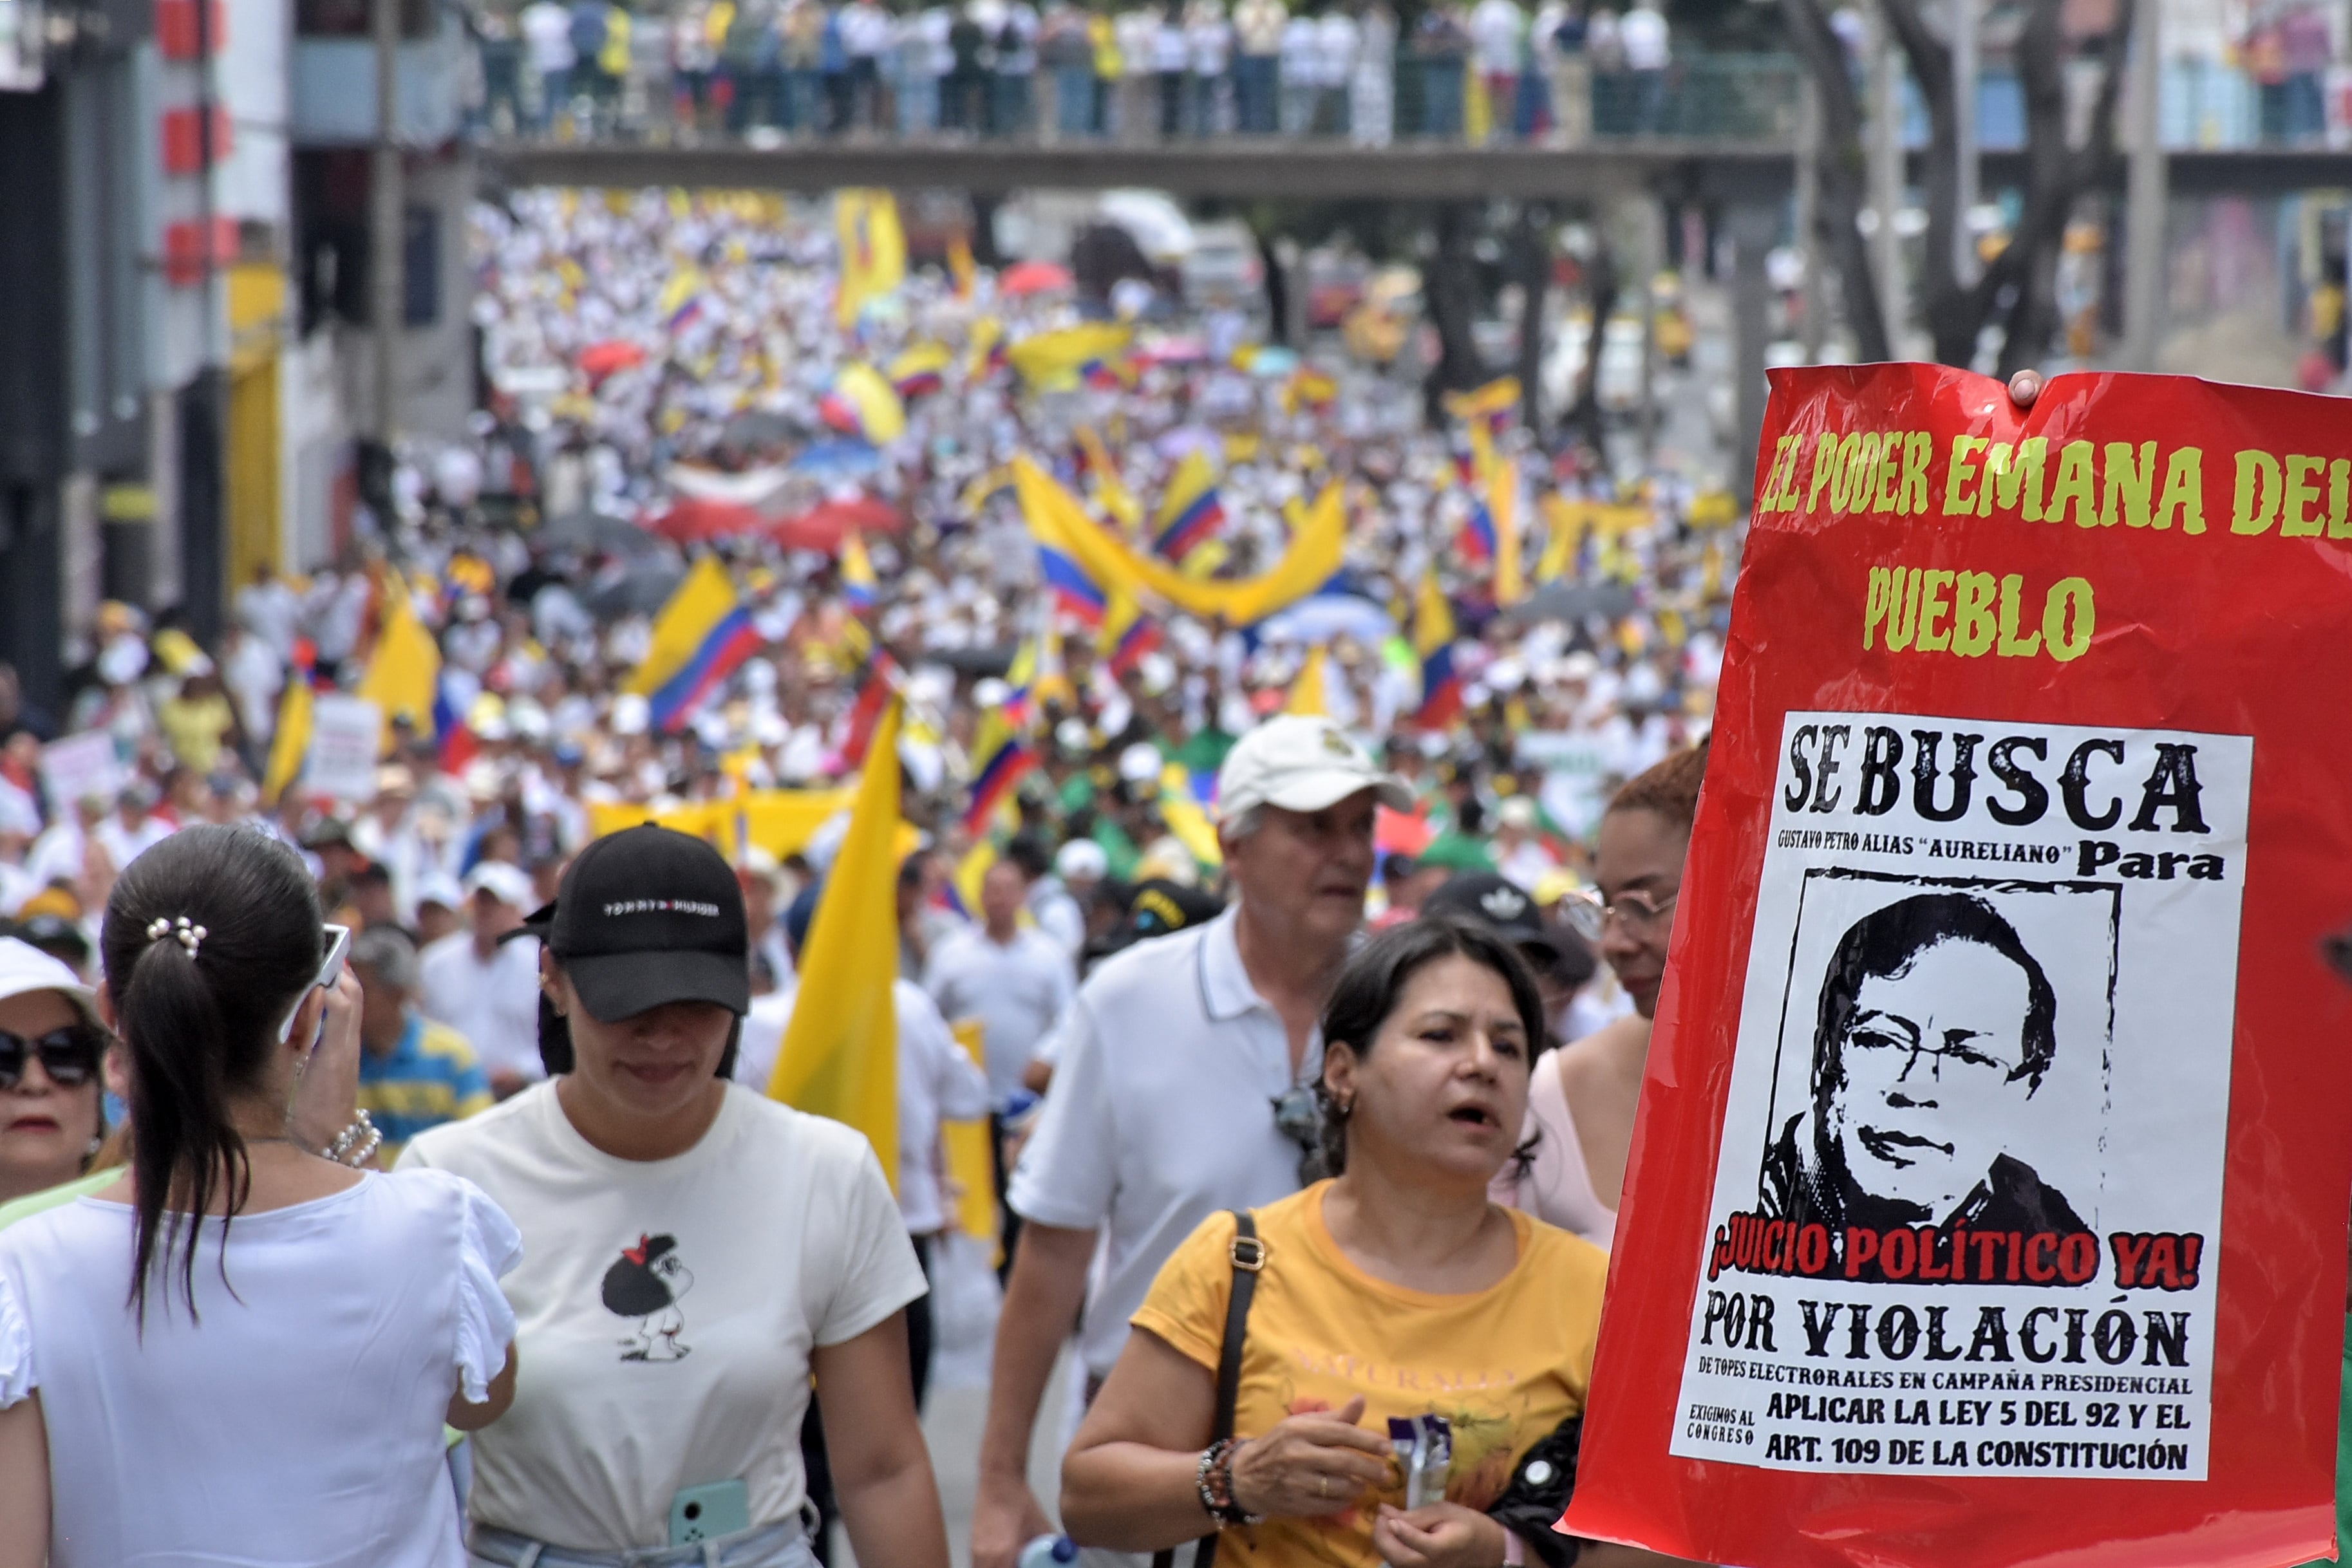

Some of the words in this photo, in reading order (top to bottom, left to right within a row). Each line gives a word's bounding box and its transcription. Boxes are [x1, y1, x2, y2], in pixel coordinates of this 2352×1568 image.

[1760, 433, 1803, 514] EL
[1806, 430, 1932, 516] PODER
[1942, 434, 2206, 536] EMANA
[2230, 449, 2352, 540] DEL
[1863, 566, 2096, 662] PUEBLO
[1784, 723, 1850, 814] SE
[1852, 725, 2211, 834] BUSCA
[1778, 829, 1821, 848] GUSTAVO
[1823, 831, 1858, 851] PETRO
[1861, 833, 1914, 855] ALIAS
[2077, 840, 2225, 881] Para
[1708, 1213, 1830, 1281] ¡JUICIO
[1845, 1218, 2098, 1283] POLÍTICO
[2112, 1233, 2202, 1288] YA!
[1700, 1289, 1778, 1352] POR
[1798, 1294, 2191, 1367] VIOLACIÓN
[1698, 1356, 1713, 1373] DE
[1714, 1358, 1746, 1378] TOPES
[1749, 1362, 1894, 1389] ELECTRORALES
[1899, 1373, 1926, 1390] EN
[1932, 1369, 2035, 1390] CAMPAÑA
[2042, 1374, 2193, 1394] PRESIDENCIAL
[1689, 1404, 1736, 1424] EXIGIMOS
[1738, 1410, 1755, 1426] AL
[1766, 1392, 1885, 1424] APLICAR
[1894, 1399, 1931, 1426] LA
[1939, 1400, 1993, 1426] LEY
[2000, 1401, 2017, 1426] 5
[2025, 1401, 2077, 1427] DEL
[2085, 1402, 2120, 1428] 92
[2128, 1404, 2148, 1428] Y
[2156, 1404, 2190, 1429] EL
[1687, 1423, 1754, 1445] CONGRESO
[1765, 1433, 1823, 1462] ART.
[1832, 1437, 1880, 1464] 109
[1888, 1439, 1924, 1465] DE
[1932, 1440, 1968, 1468] LA
[1977, 1437, 2188, 1470] CONSTITUCIÓN
